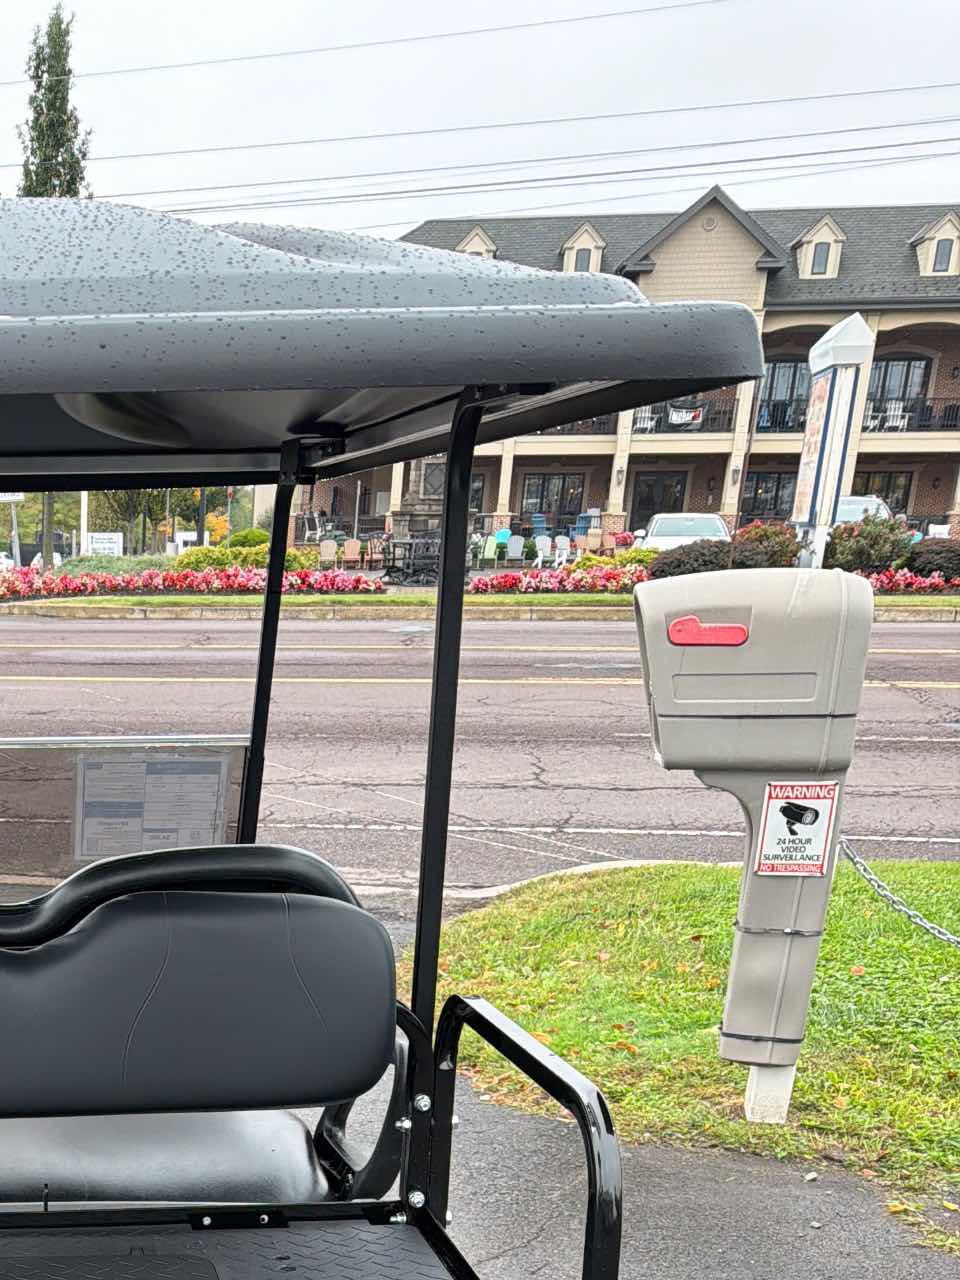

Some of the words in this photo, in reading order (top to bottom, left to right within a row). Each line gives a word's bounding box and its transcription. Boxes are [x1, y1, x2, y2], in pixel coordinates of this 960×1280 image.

[771, 786, 835, 798] WARNING
[760, 864, 772, 872] NO
[773, 864, 821, 872] TRESPASSING
